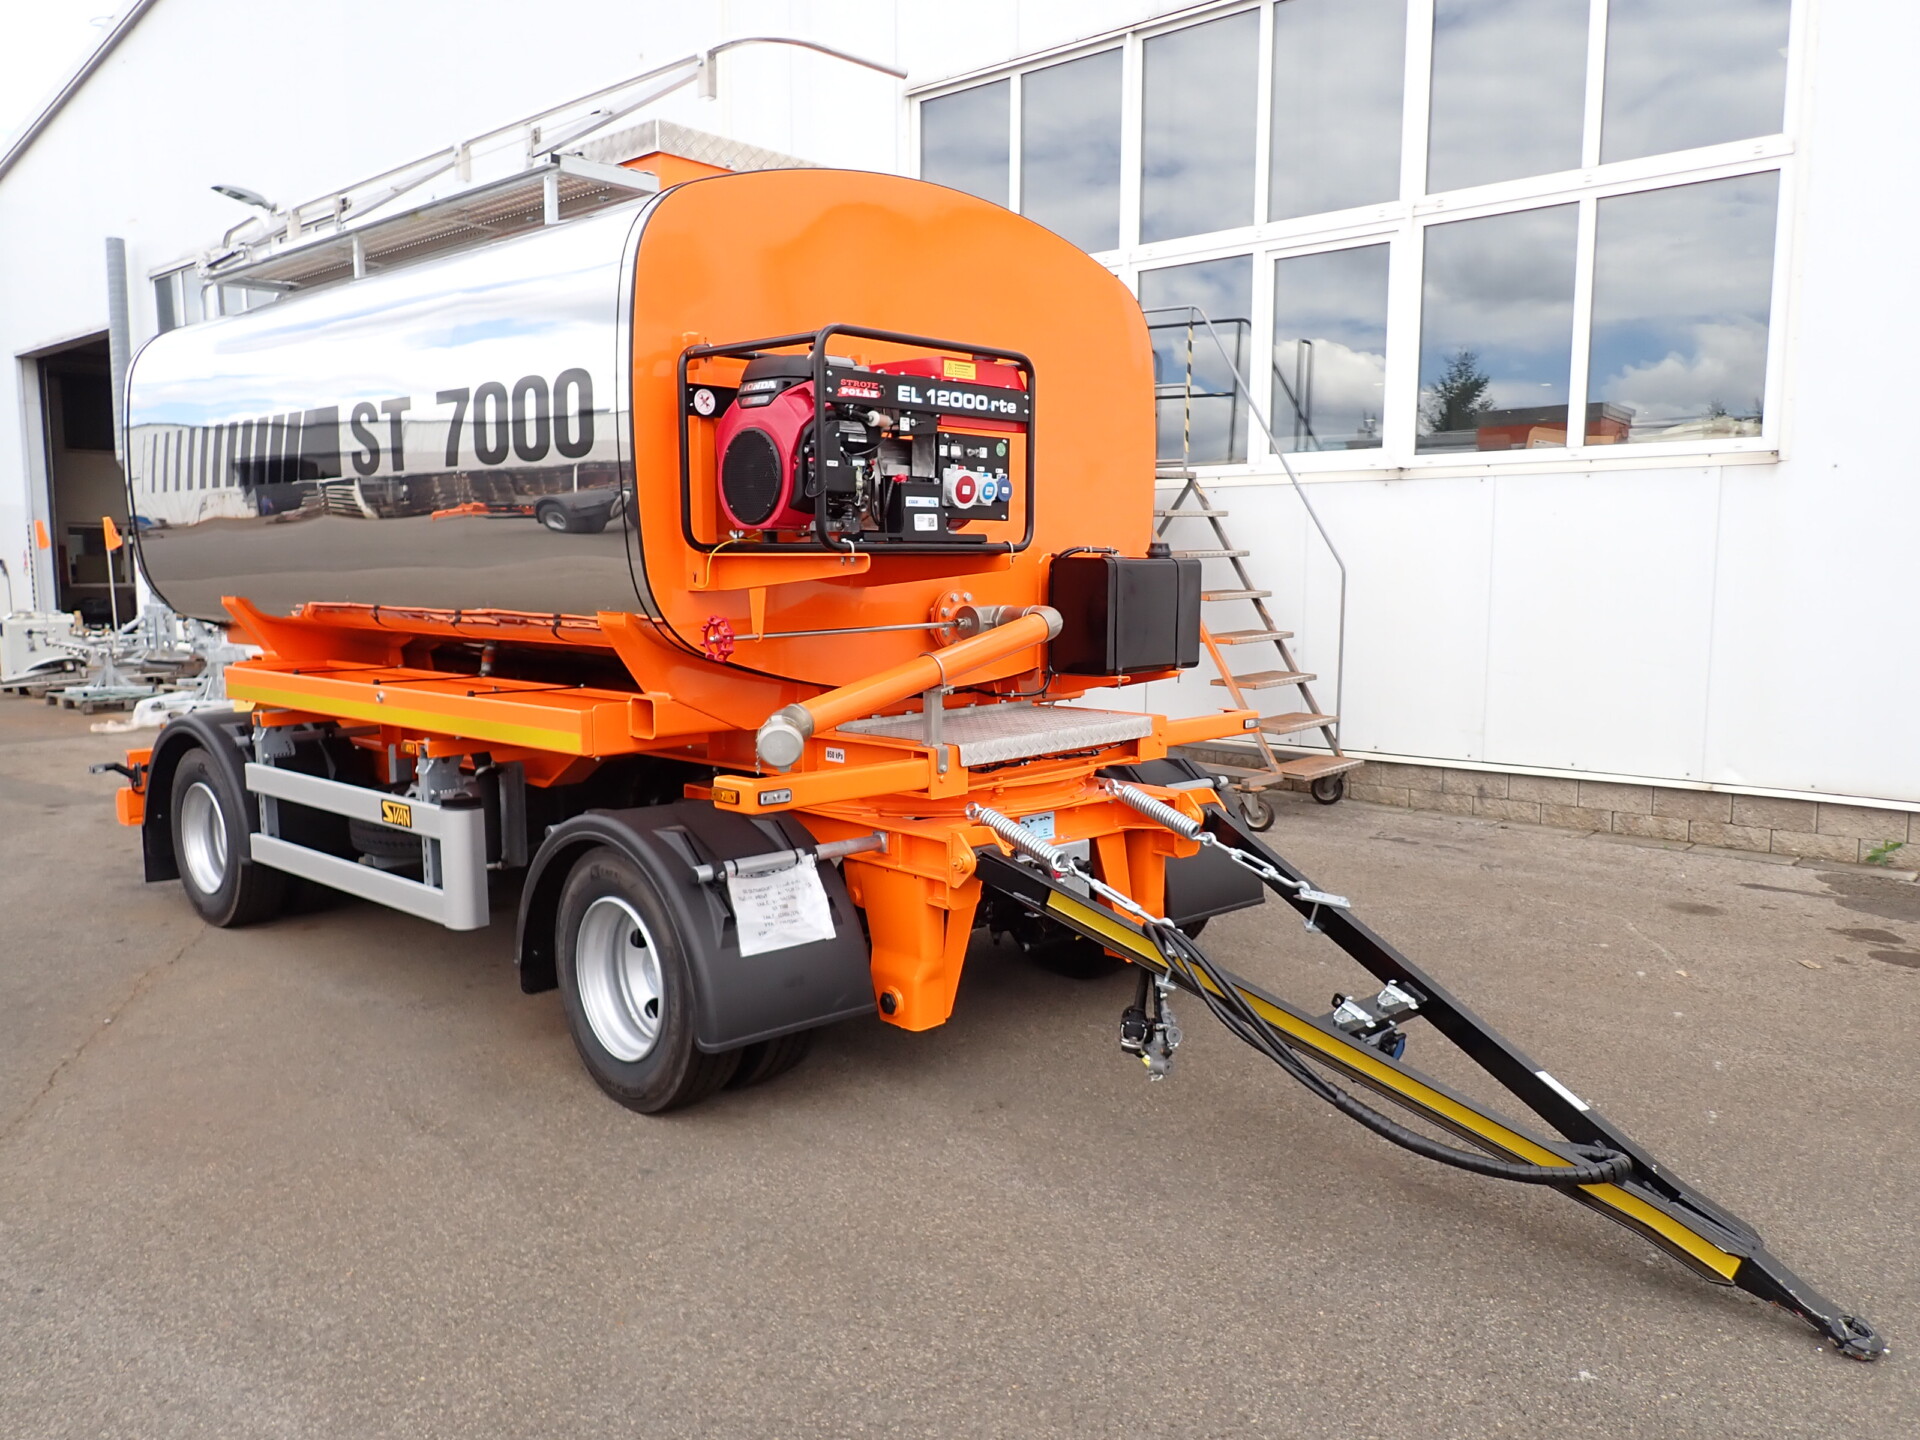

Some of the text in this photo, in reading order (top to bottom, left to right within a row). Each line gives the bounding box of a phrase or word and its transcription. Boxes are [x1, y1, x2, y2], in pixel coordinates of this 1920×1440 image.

[740, 380, 778, 392] HONDA
[840, 378, 879, 390] STROJE
[841, 386, 880, 399] POLÁK
[897, 384, 923, 404] EL
[351, 367, 595, 476] ST 7000
[382, 800, 411, 828] SVAN
